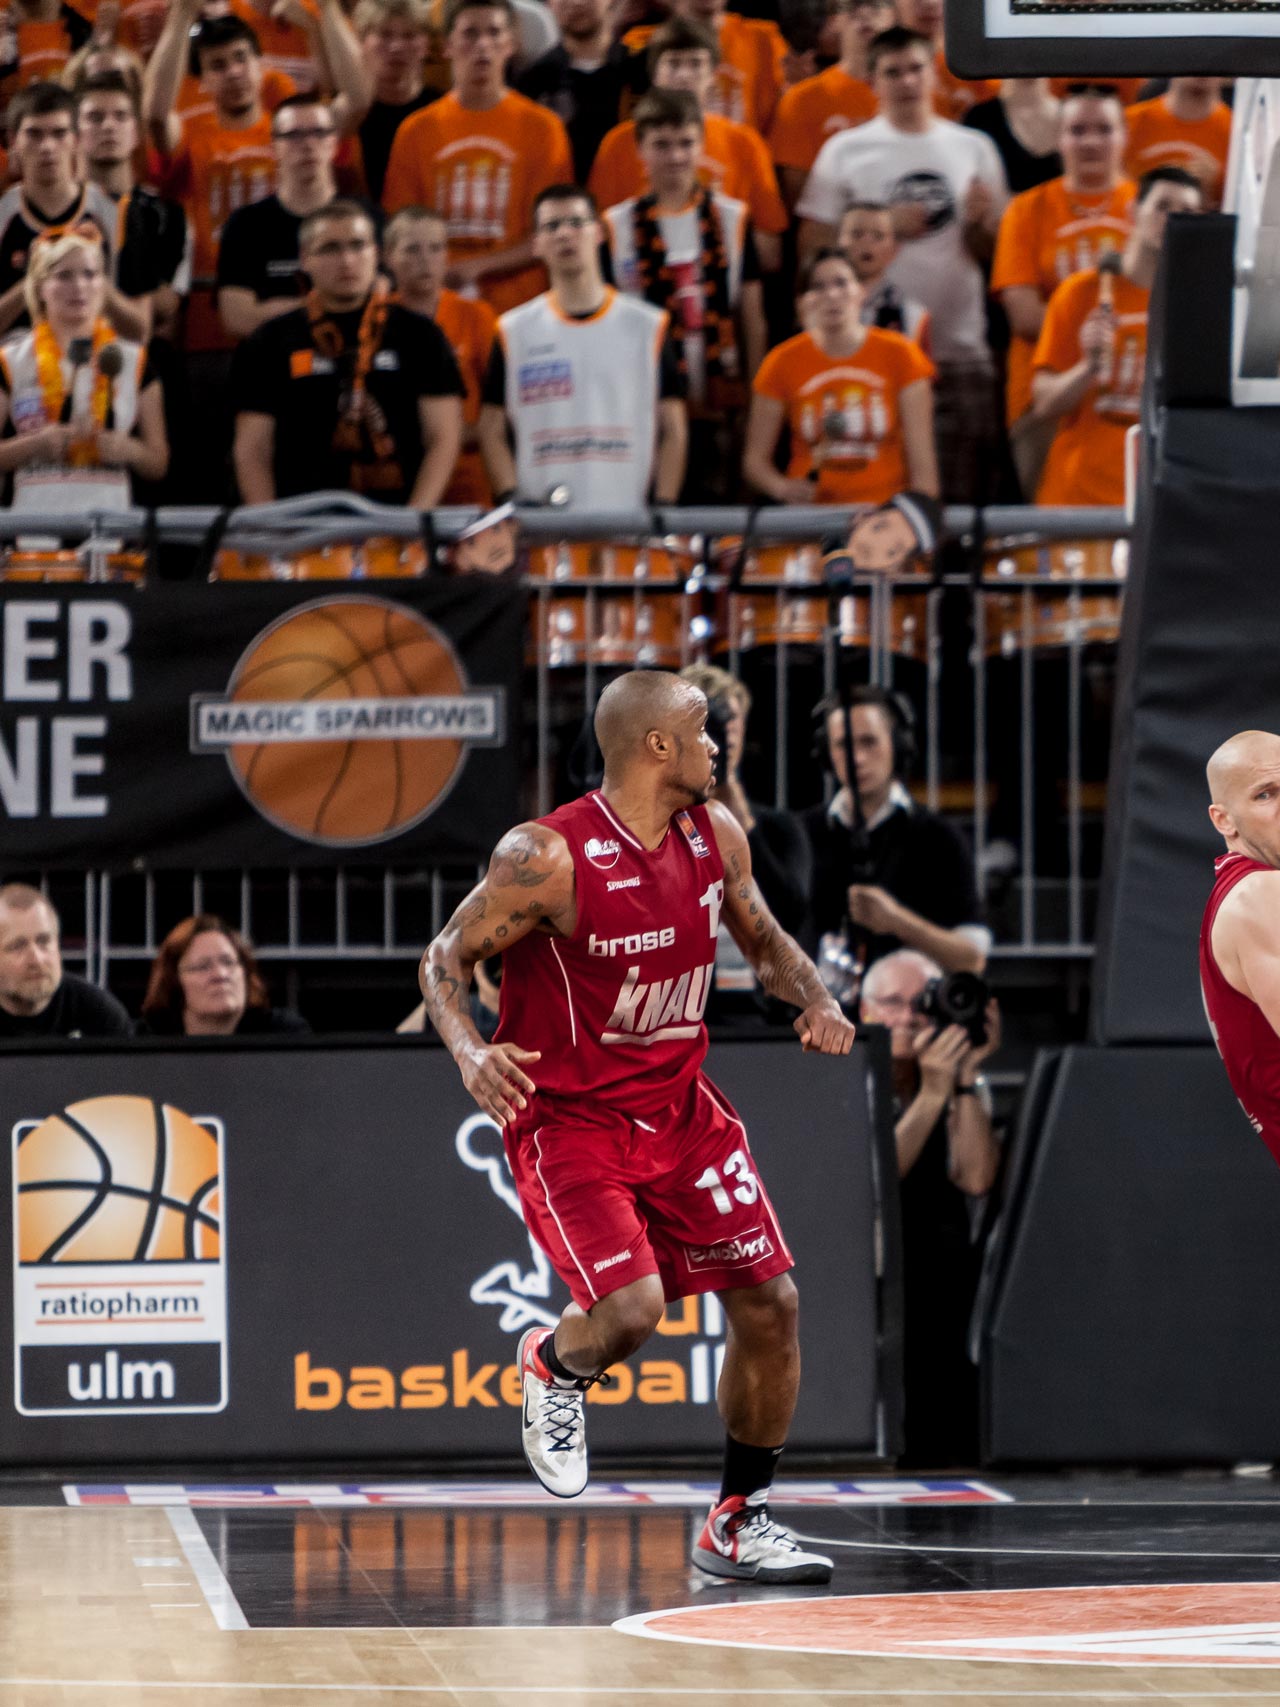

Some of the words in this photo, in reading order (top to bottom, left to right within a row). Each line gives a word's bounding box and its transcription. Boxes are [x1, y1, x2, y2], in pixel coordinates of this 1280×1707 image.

[4, 600, 133, 701] ER
[206, 710, 304, 735] MAGIC
[315, 703, 487, 731] SPARROWS
[606, 876, 640, 892] SPALDING
[699, 880, 724, 939] 1
[588, 926, 675, 957] brose
[694, 1150, 758, 1216] 13
[41, 1292, 199, 1320] ratiopharm
[67, 1350, 175, 1400] ulm
[295, 1343, 727, 1411] baskebal
